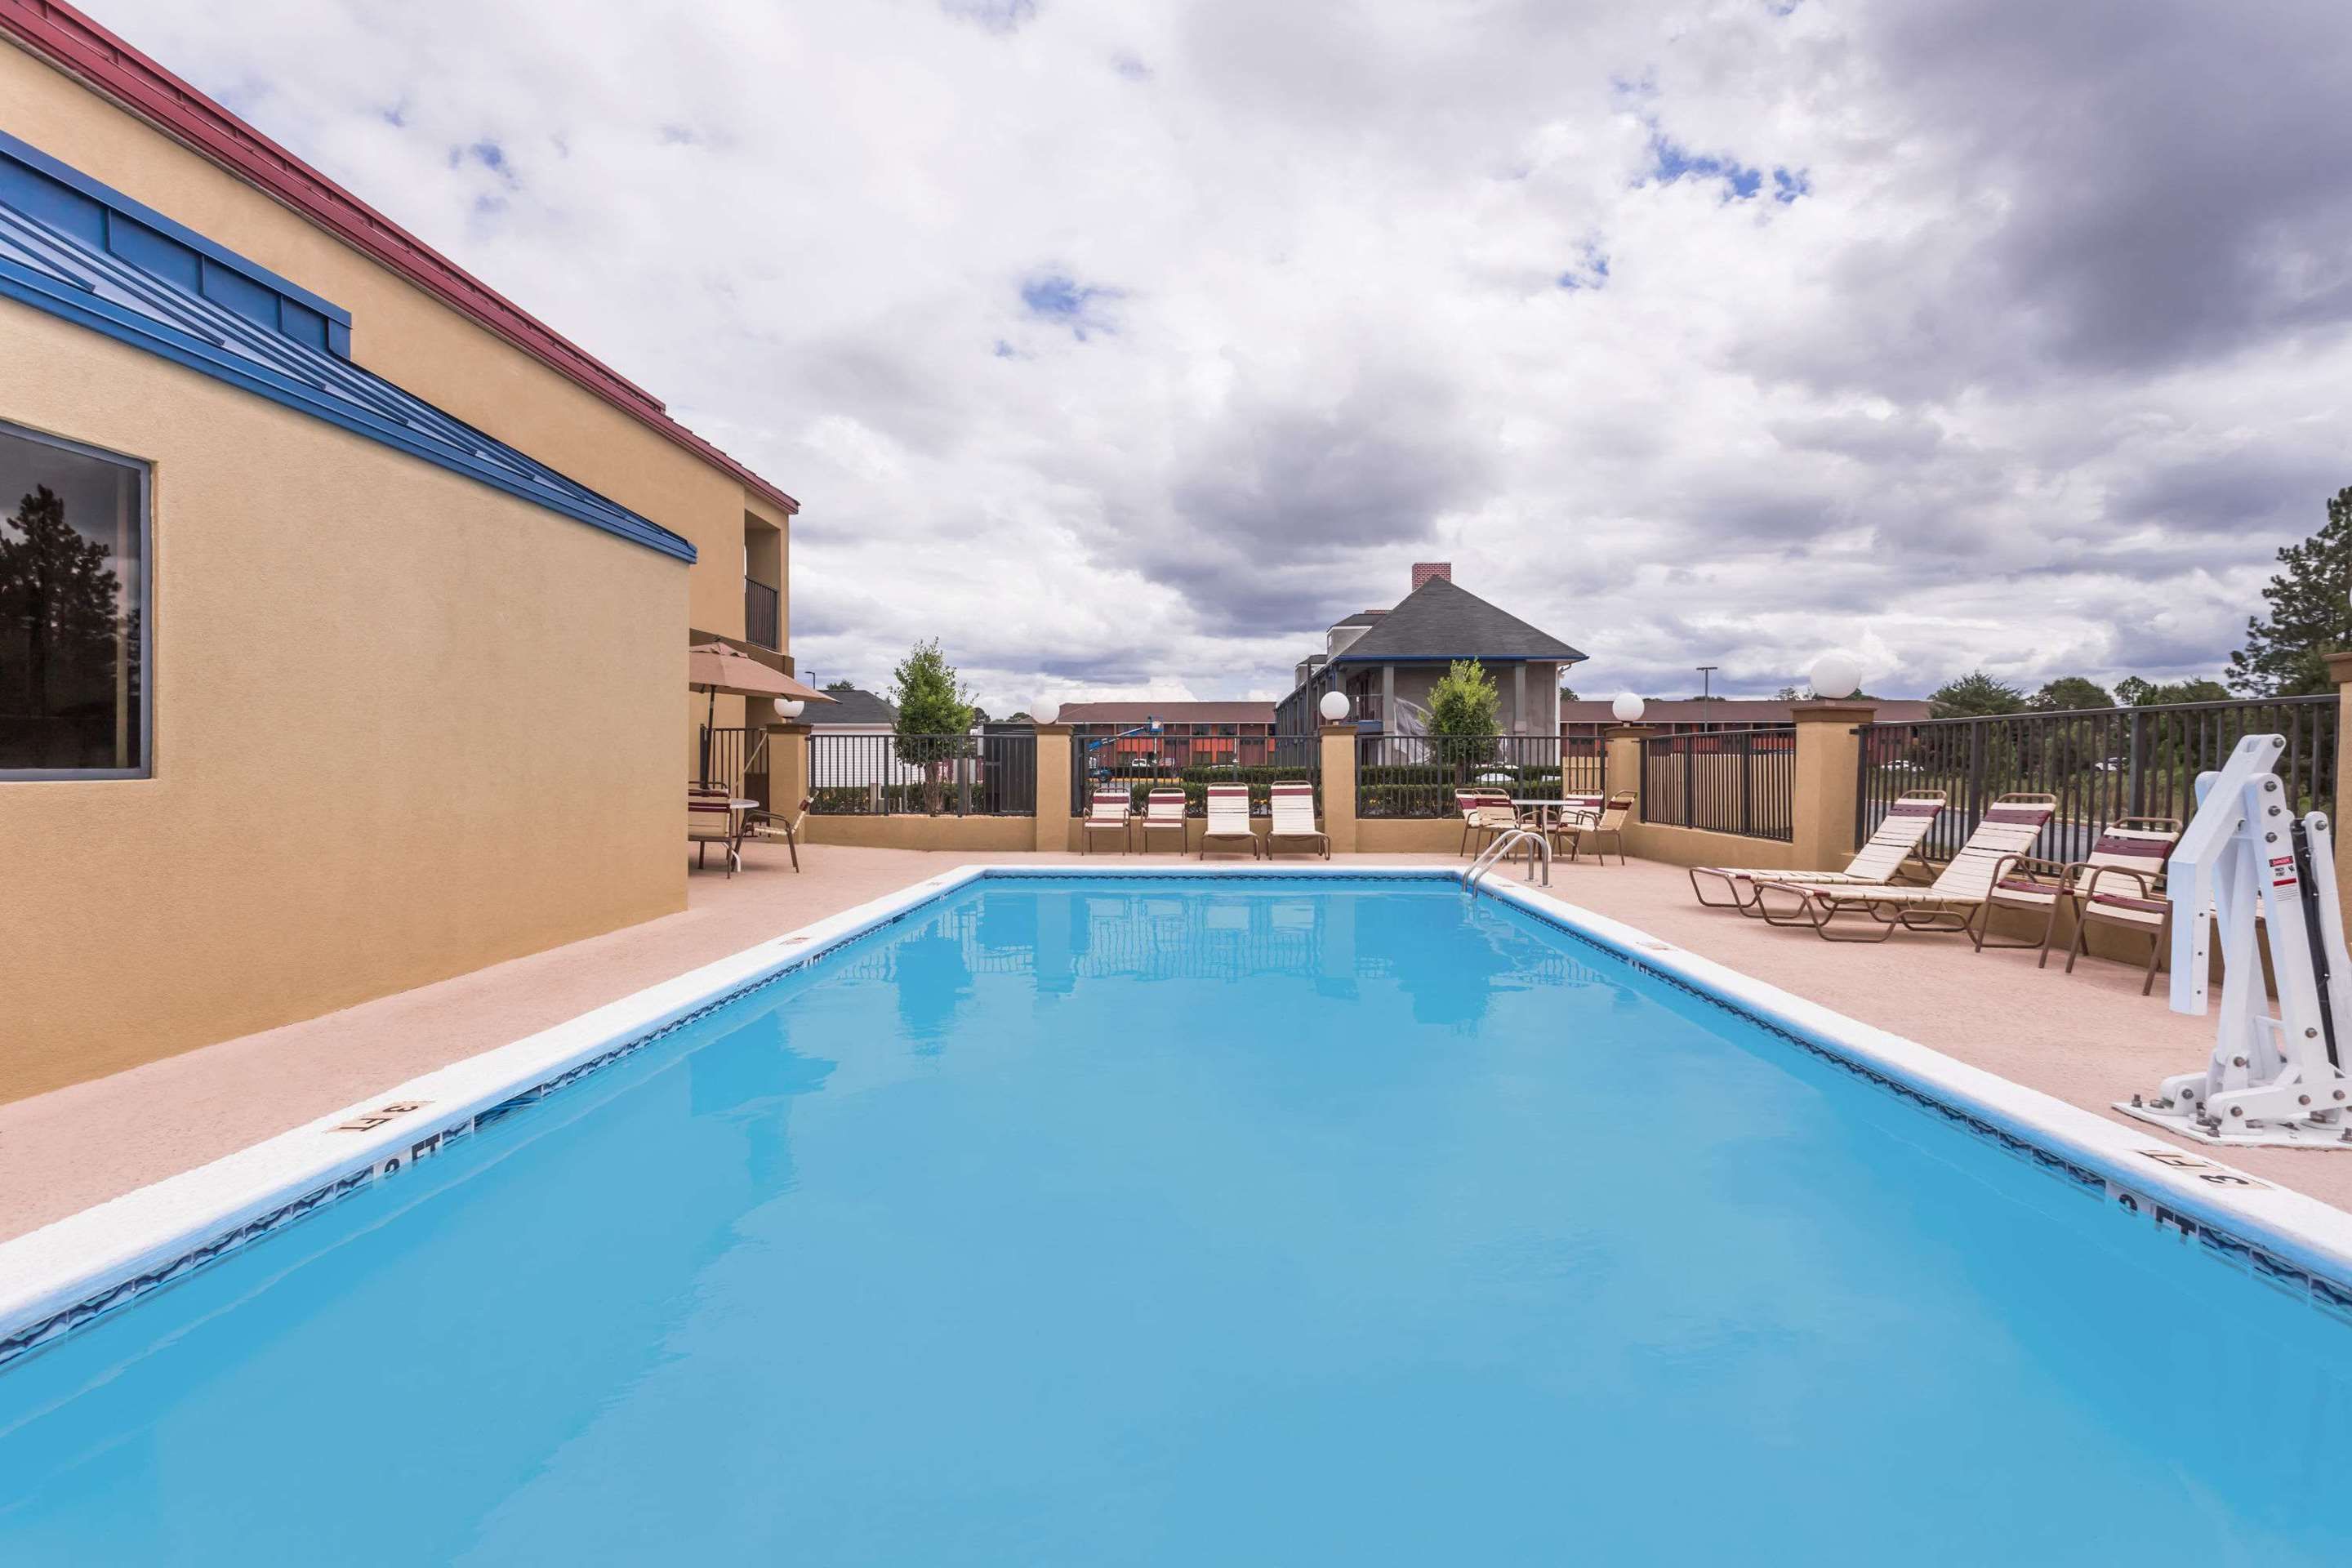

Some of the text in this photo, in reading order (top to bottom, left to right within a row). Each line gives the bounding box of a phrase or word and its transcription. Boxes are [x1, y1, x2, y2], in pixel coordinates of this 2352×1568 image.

[339, 1117, 392, 1132] FT
[412, 1133, 440, 1160] FT
[2136, 1151, 2249, 1184] 3 FT
